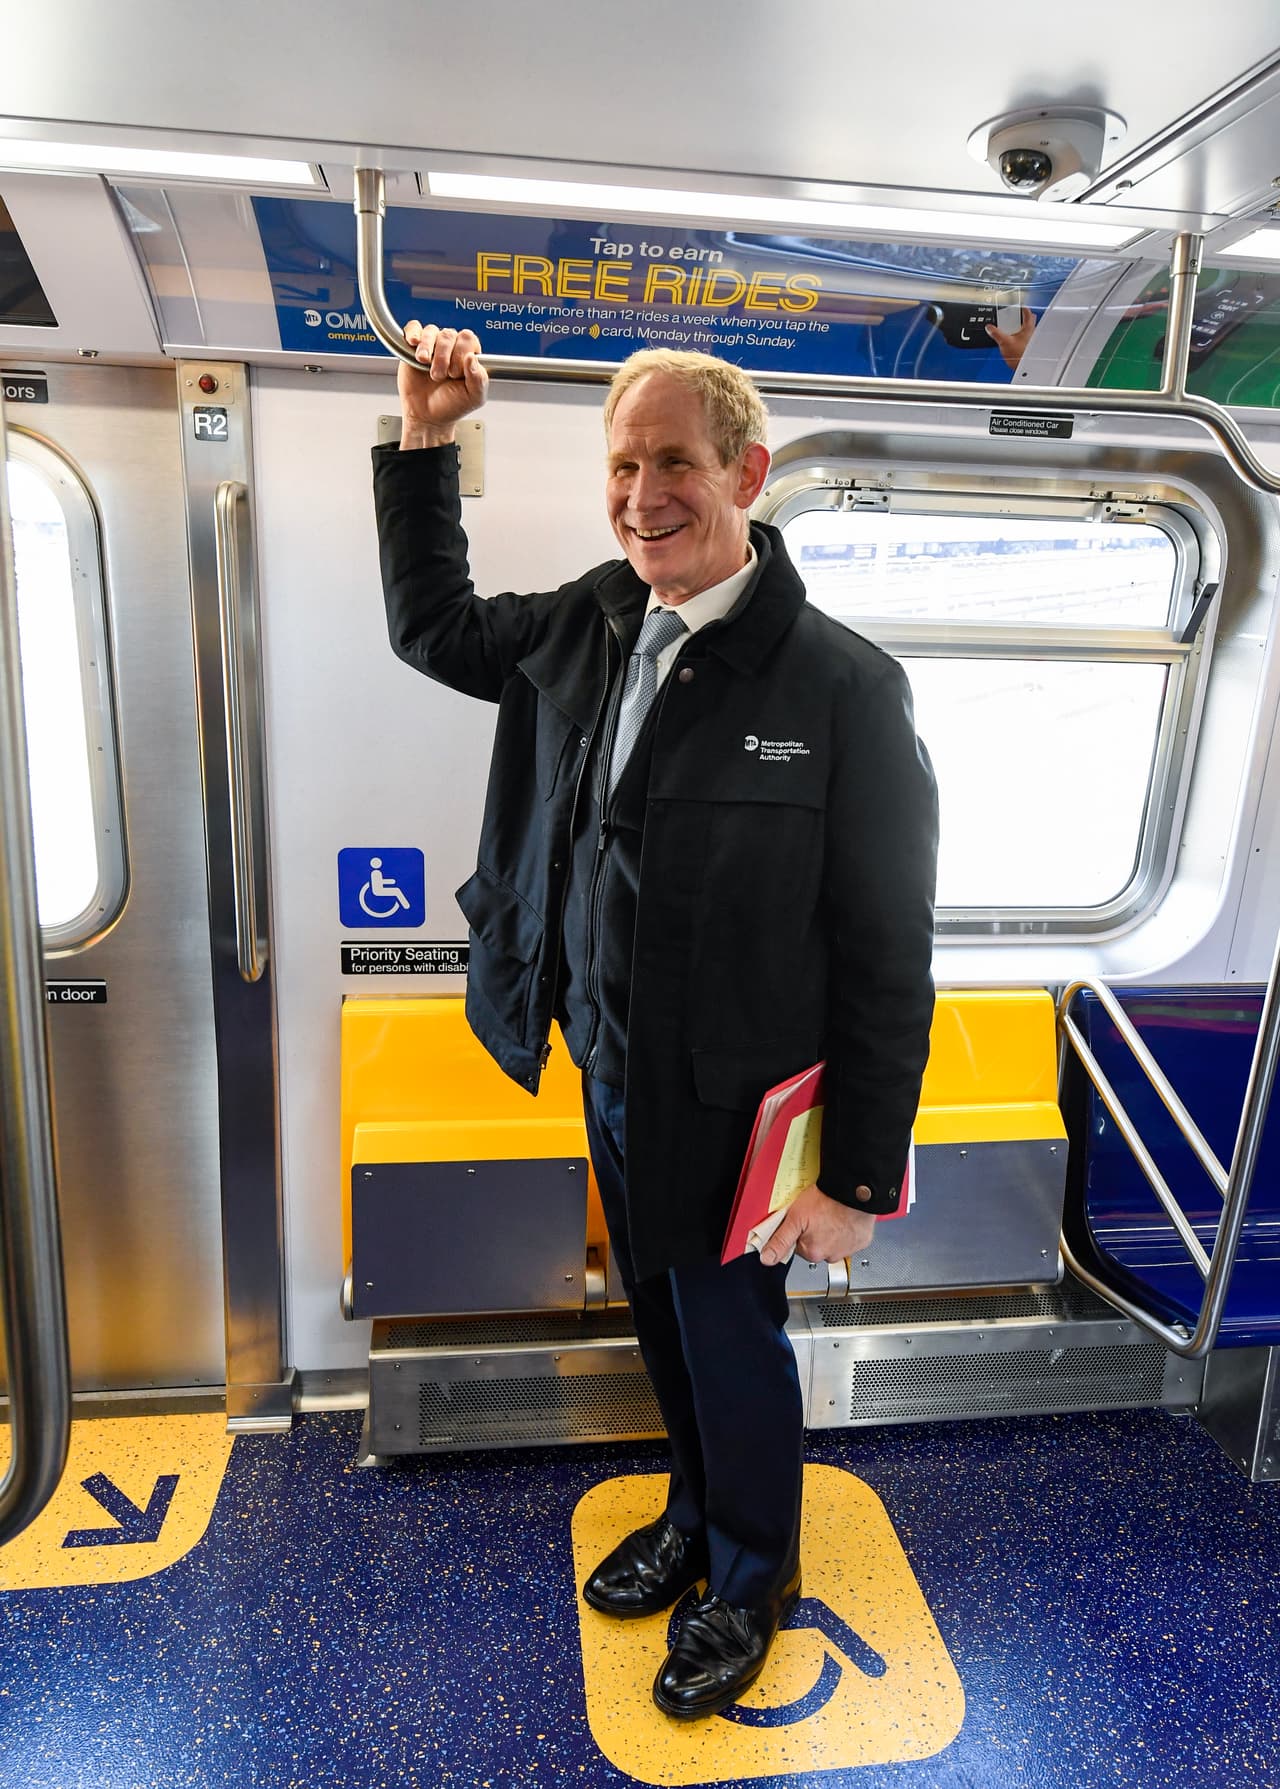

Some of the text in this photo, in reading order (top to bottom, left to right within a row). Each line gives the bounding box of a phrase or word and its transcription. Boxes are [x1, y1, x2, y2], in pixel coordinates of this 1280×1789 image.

[590, 237, 724, 263] Tap to earn
[476, 251, 823, 313] FREE RIDES
[455, 297, 830, 333] Never pay for more than 12 rides a week when you tap the
[328, 332, 376, 343] omny.info
[485, 319, 796, 347] same device or card, Monday through Sunday.
[194, 413, 227, 435] R2
[991, 418, 1059, 429] Air Conditioned Car
[761, 740, 804, 748] Metropolitan
[760, 747, 810, 755] Transportation
[759, 754, 791, 762] Authority
[351, 948, 459, 964] Priority Seating
[352, 963, 366, 972] for
[369, 964, 411, 974] persons
[413, 963, 435, 972] with
[61, 988, 96, 1000] door
